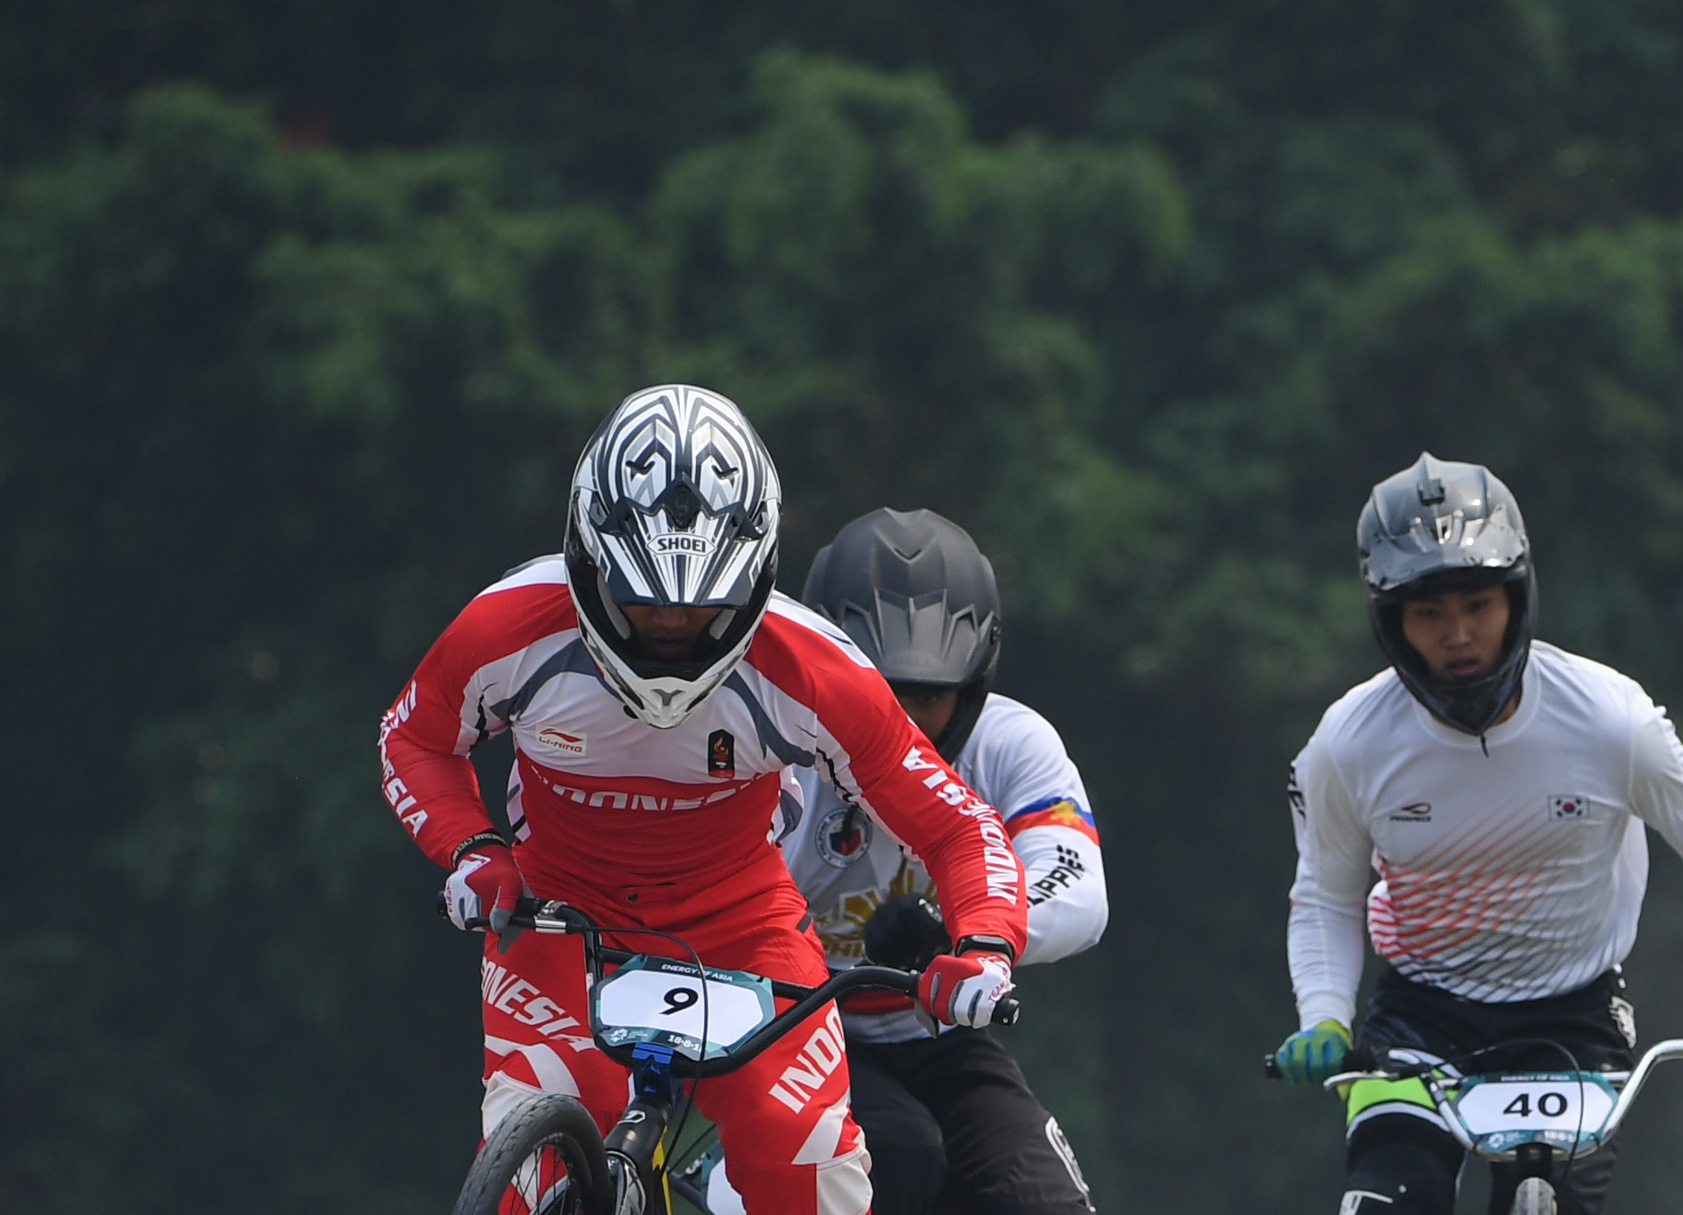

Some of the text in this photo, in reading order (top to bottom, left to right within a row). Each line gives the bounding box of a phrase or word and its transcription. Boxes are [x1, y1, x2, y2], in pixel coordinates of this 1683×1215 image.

[657, 537, 706, 553] SHOEI
[538, 736, 583, 753] LI-NING
[661, 963, 698, 975] ENERGY
[711, 972, 734, 982] ASIA
[658, 987, 699, 1016] 9
[768, 997, 846, 1115] INDO
[1503, 1092, 1568, 1117] 40
